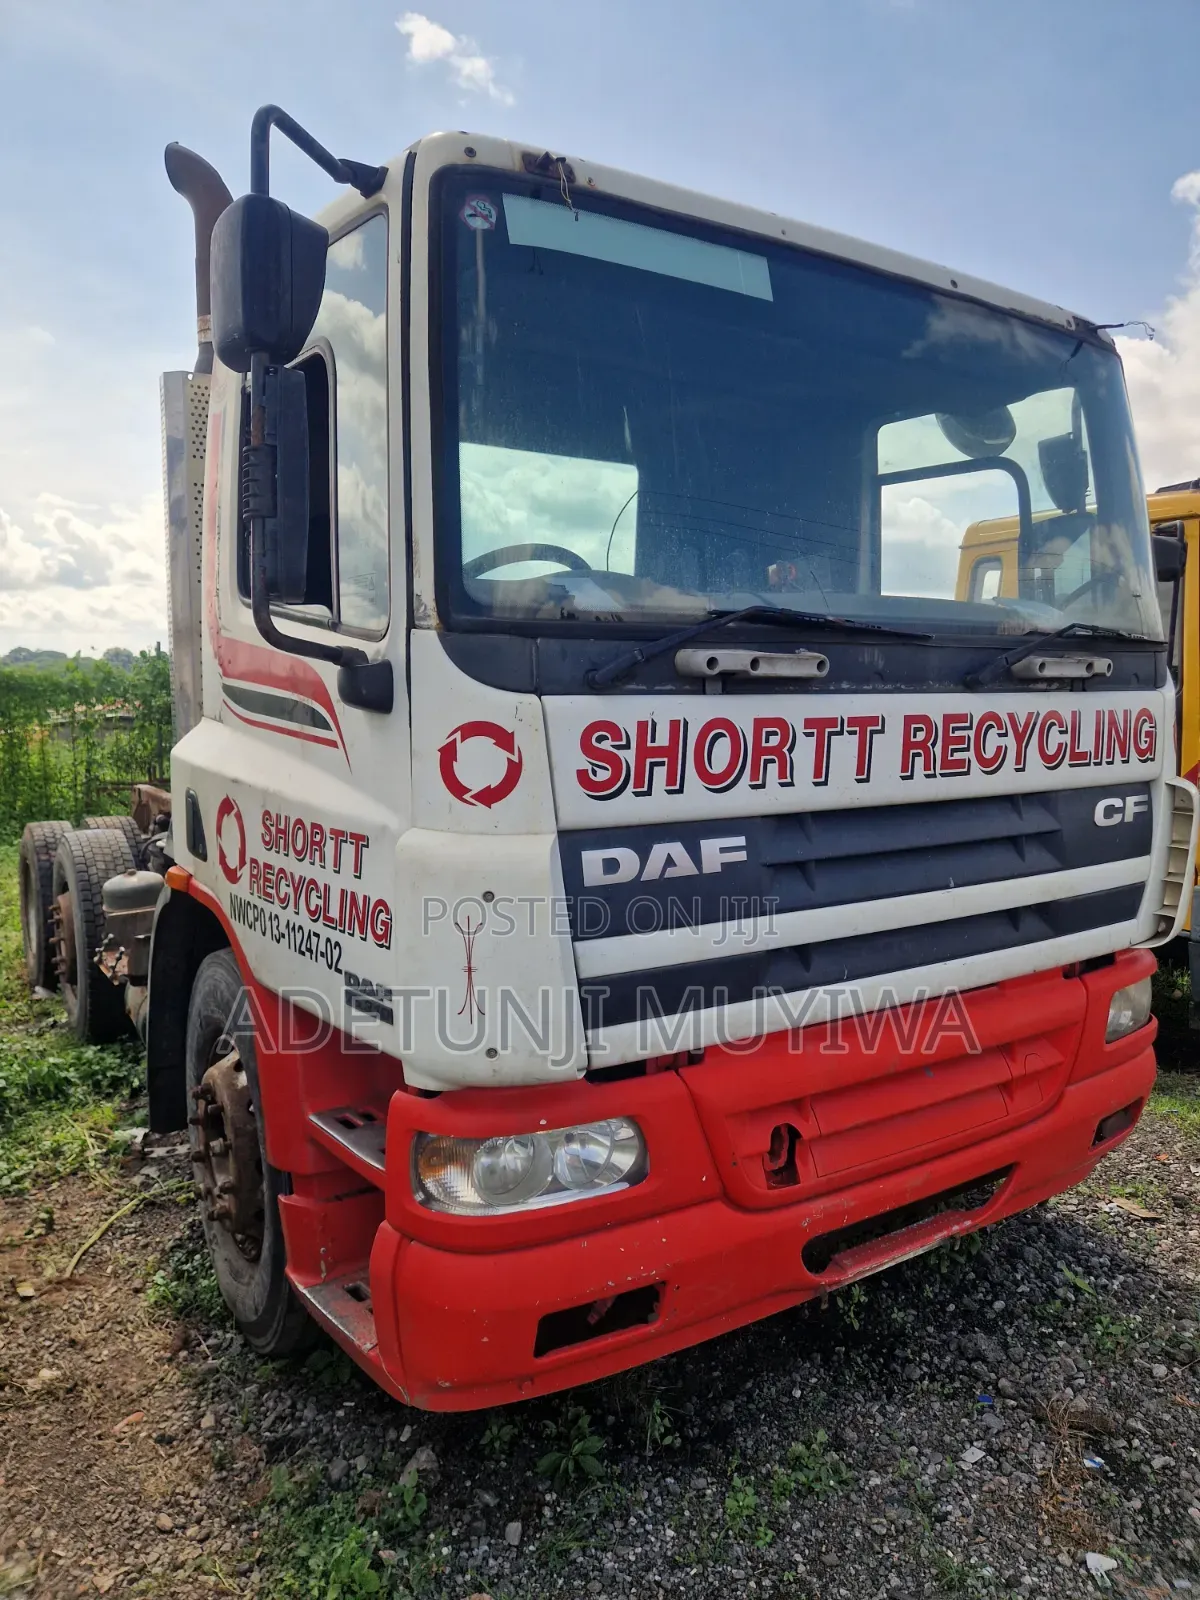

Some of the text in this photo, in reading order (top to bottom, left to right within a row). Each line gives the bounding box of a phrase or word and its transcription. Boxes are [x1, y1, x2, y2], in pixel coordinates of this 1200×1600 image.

[576, 708, 1157, 800] SHORTT RECYCLING
[261, 809, 369, 879] SHORTT
[1094, 795, 1149, 827] CF
[581, 836, 747, 887] DAF
[249, 857, 393, 949] RECYCLING
